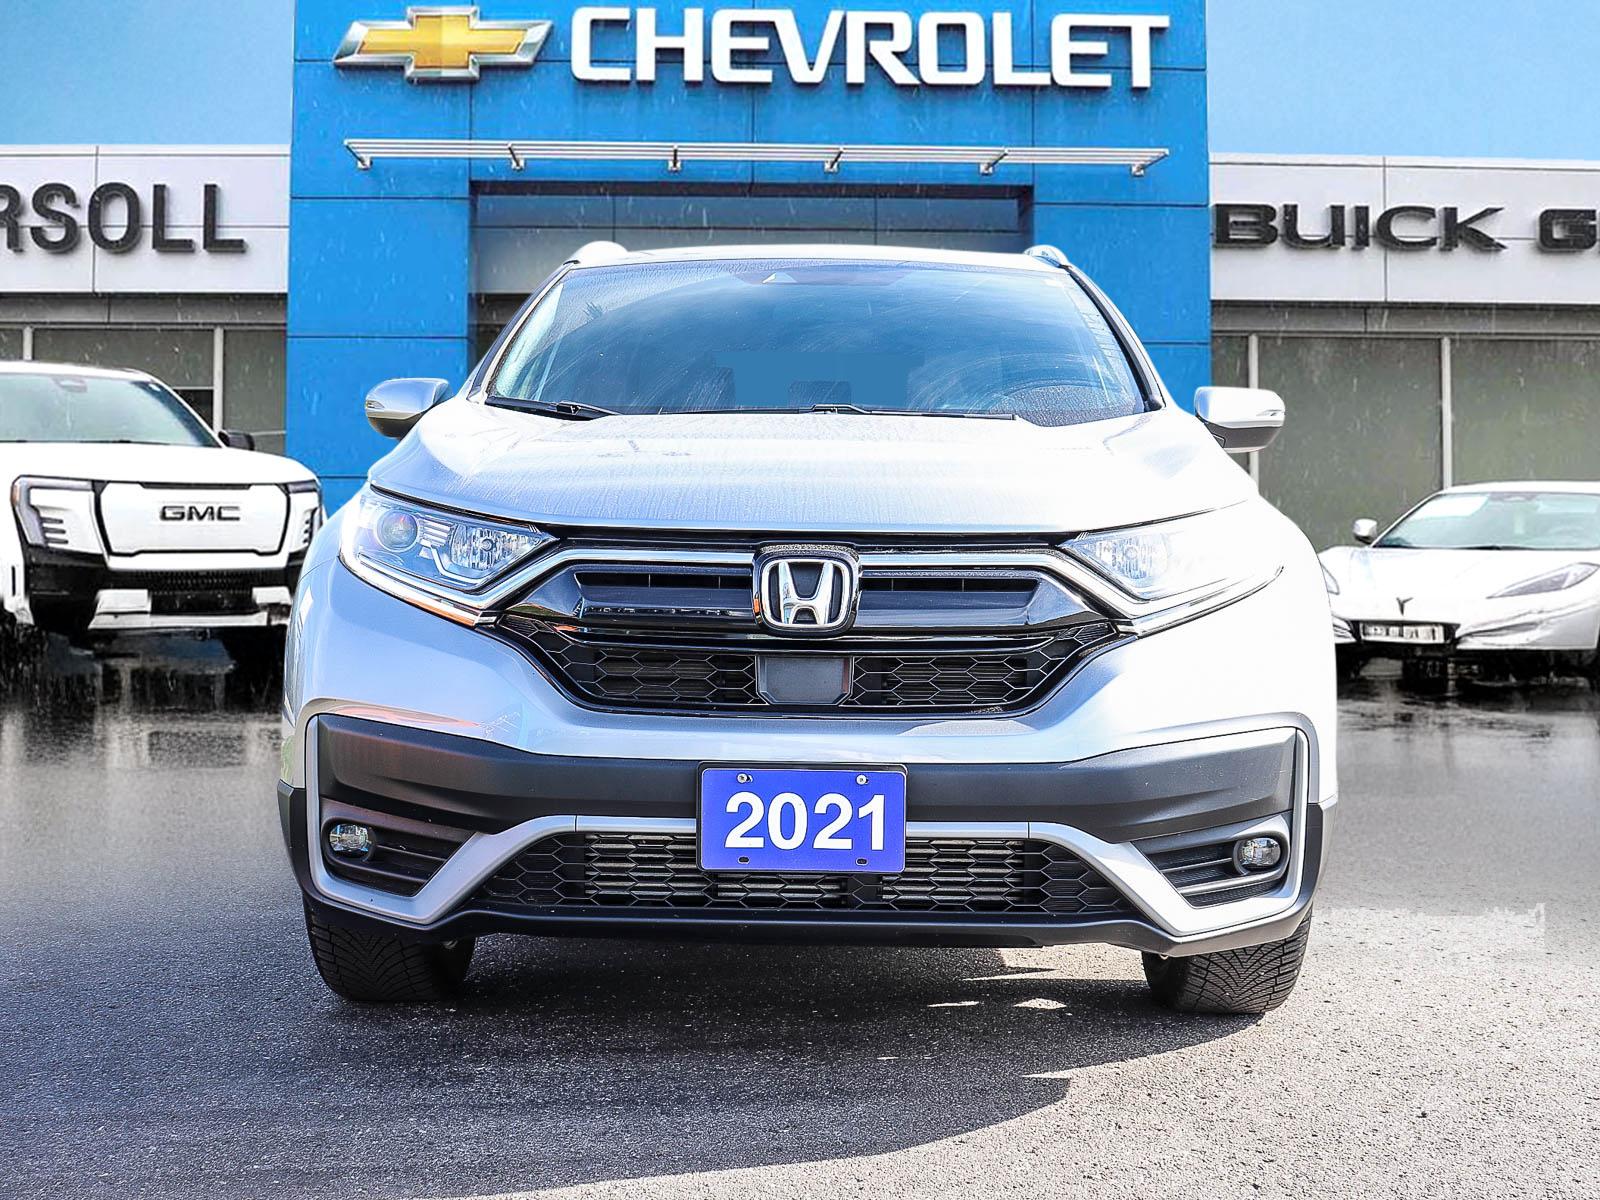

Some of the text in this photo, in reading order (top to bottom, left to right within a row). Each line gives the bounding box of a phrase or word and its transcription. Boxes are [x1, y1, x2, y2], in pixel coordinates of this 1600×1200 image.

[570, 6, 1170, 90] CHEVROLET
[1213, 203, 1507, 250] BUICK
[160, 505, 240, 521] GMC
[724, 791, 885, 851] 2021
